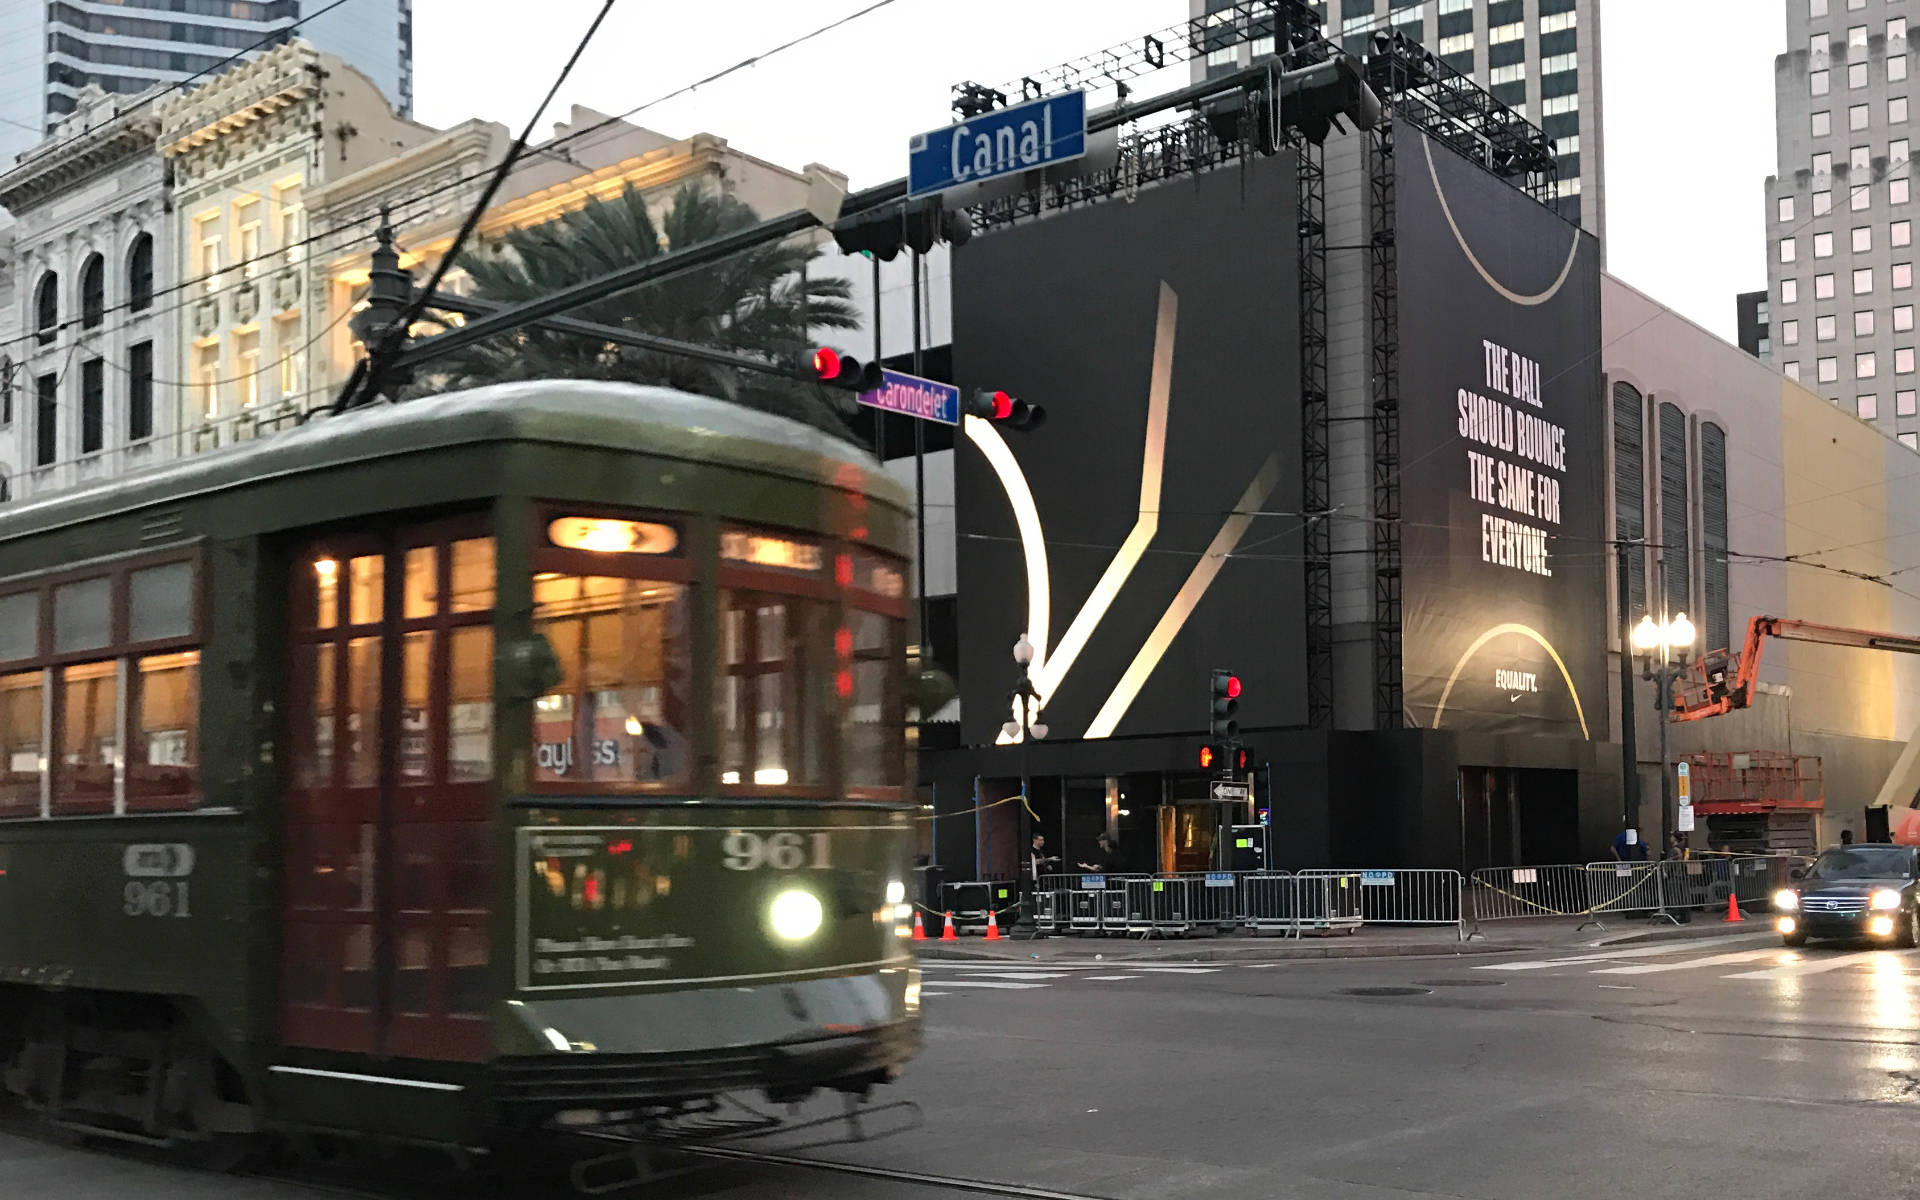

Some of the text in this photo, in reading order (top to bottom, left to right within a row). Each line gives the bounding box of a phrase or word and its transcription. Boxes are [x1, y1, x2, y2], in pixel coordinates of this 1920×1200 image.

[951, 104, 1052, 182] Canal
[1483, 339, 1543, 409] THE BALL
[1458, 388, 1566, 473] SHOULD BOUNCE
[1467, 450, 1560, 524] THE SAME FOR
[1482, 513, 1552, 577] EVERYONE.
[1495, 668, 1538, 693] EQUALITY.
[721, 831, 834, 872] 961
[123, 881, 193, 918] 961
